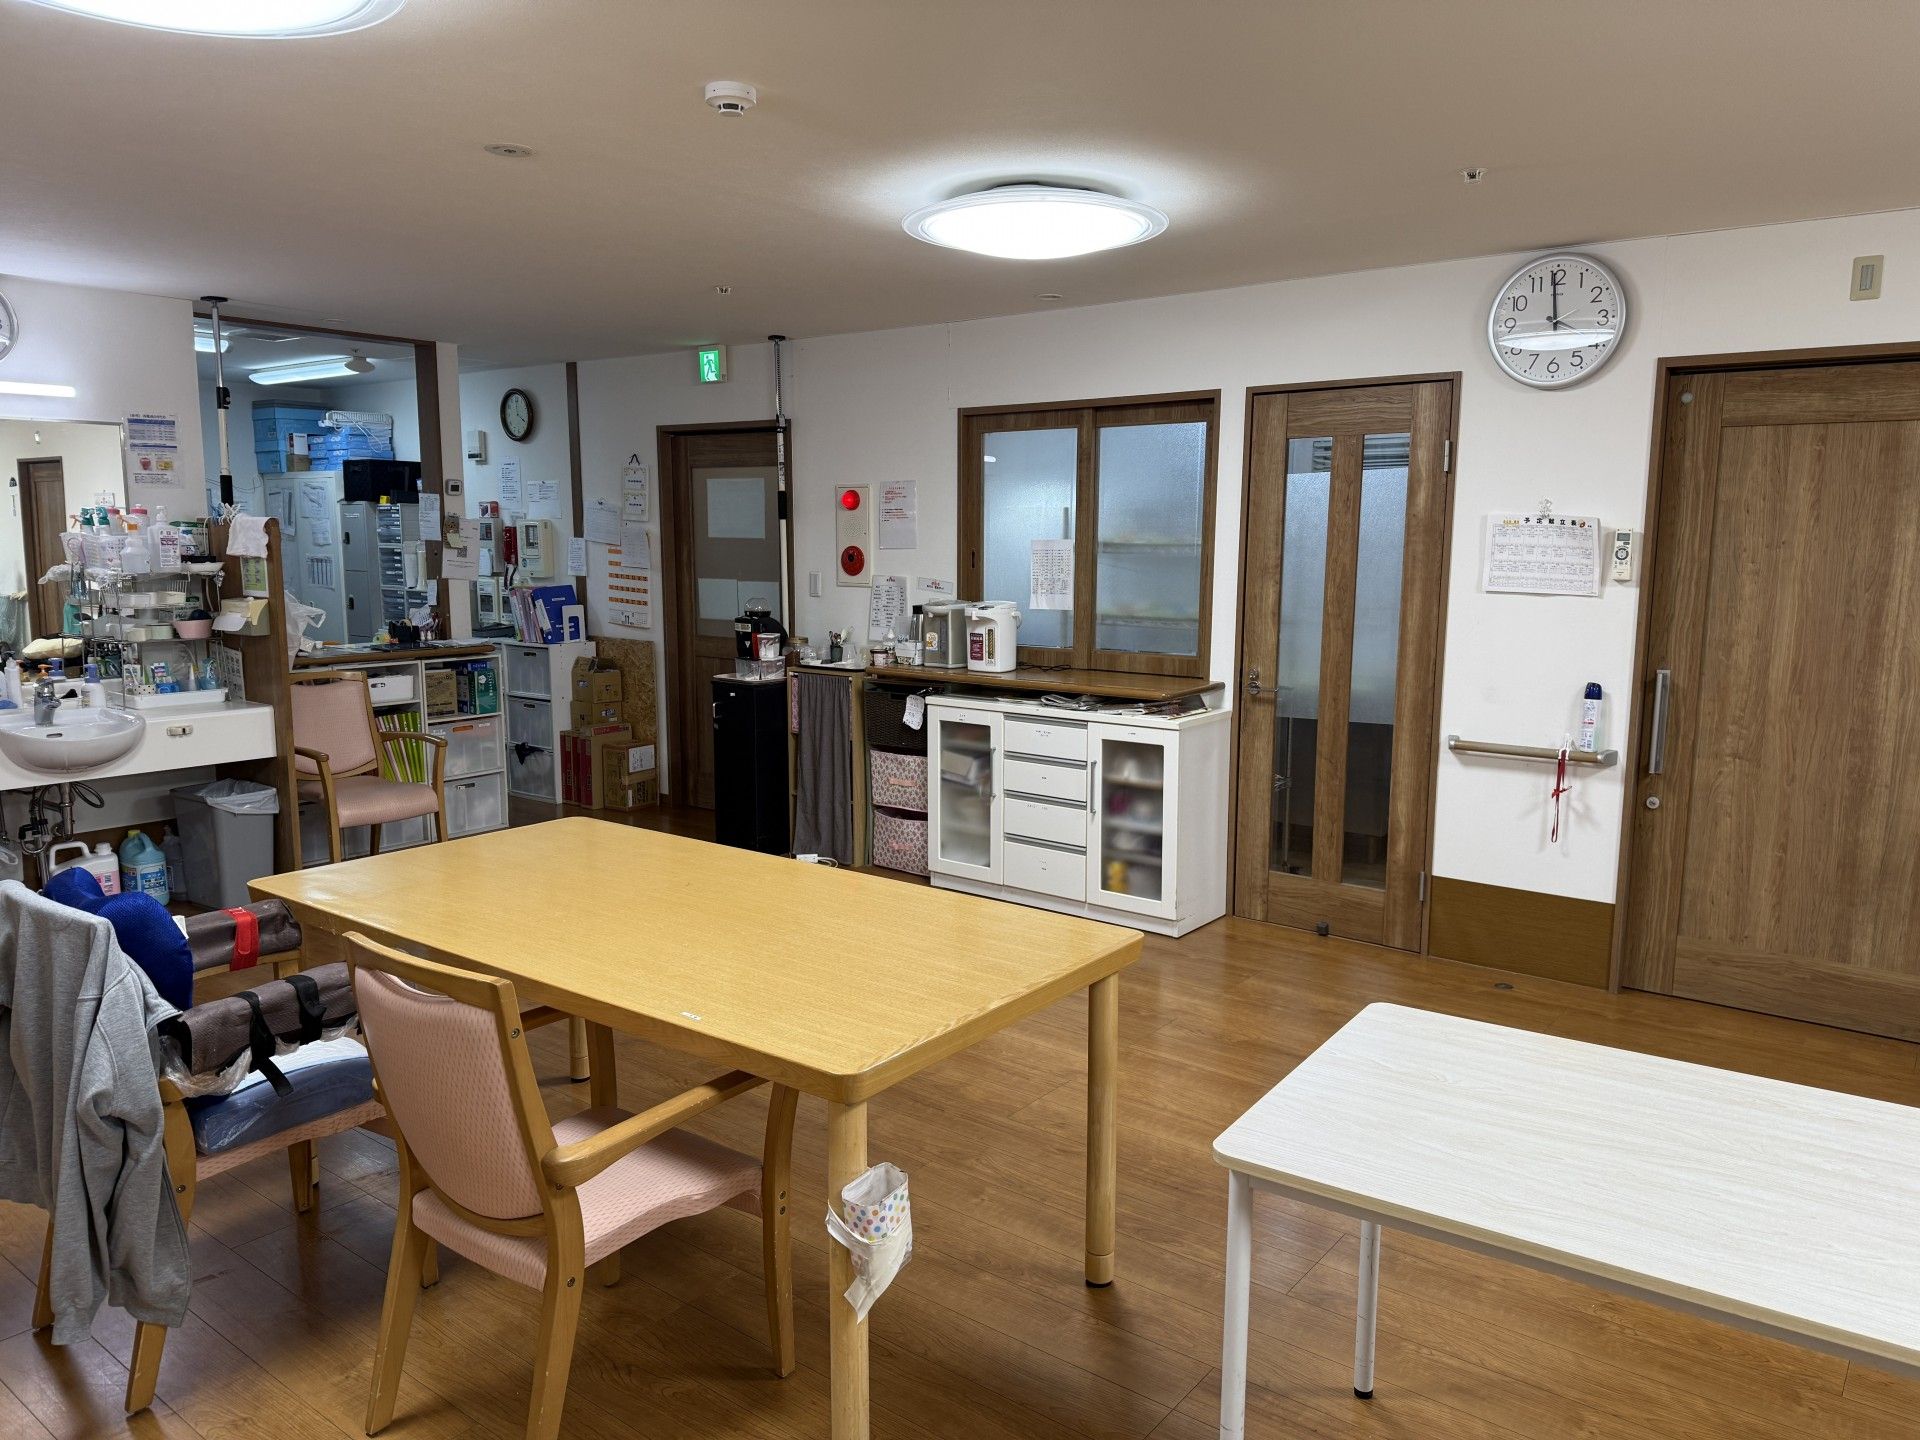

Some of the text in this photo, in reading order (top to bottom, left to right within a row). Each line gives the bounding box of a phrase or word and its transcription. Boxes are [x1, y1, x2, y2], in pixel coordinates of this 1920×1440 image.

[1531, 277, 1543, 293] 11
[1550, 269, 1566, 286] 12
[1579, 272, 1584, 289] 1
[1511, 295, 1527, 311] 10
[1590, 286, 1602, 303] 2
[1504, 317, 1517, 333] 9
[1596, 309, 1609, 326] 3
[1528, 353, 1540, 370] 7
[1546, 357, 1560, 373] 6
[1569, 350, 1584, 367] 5
